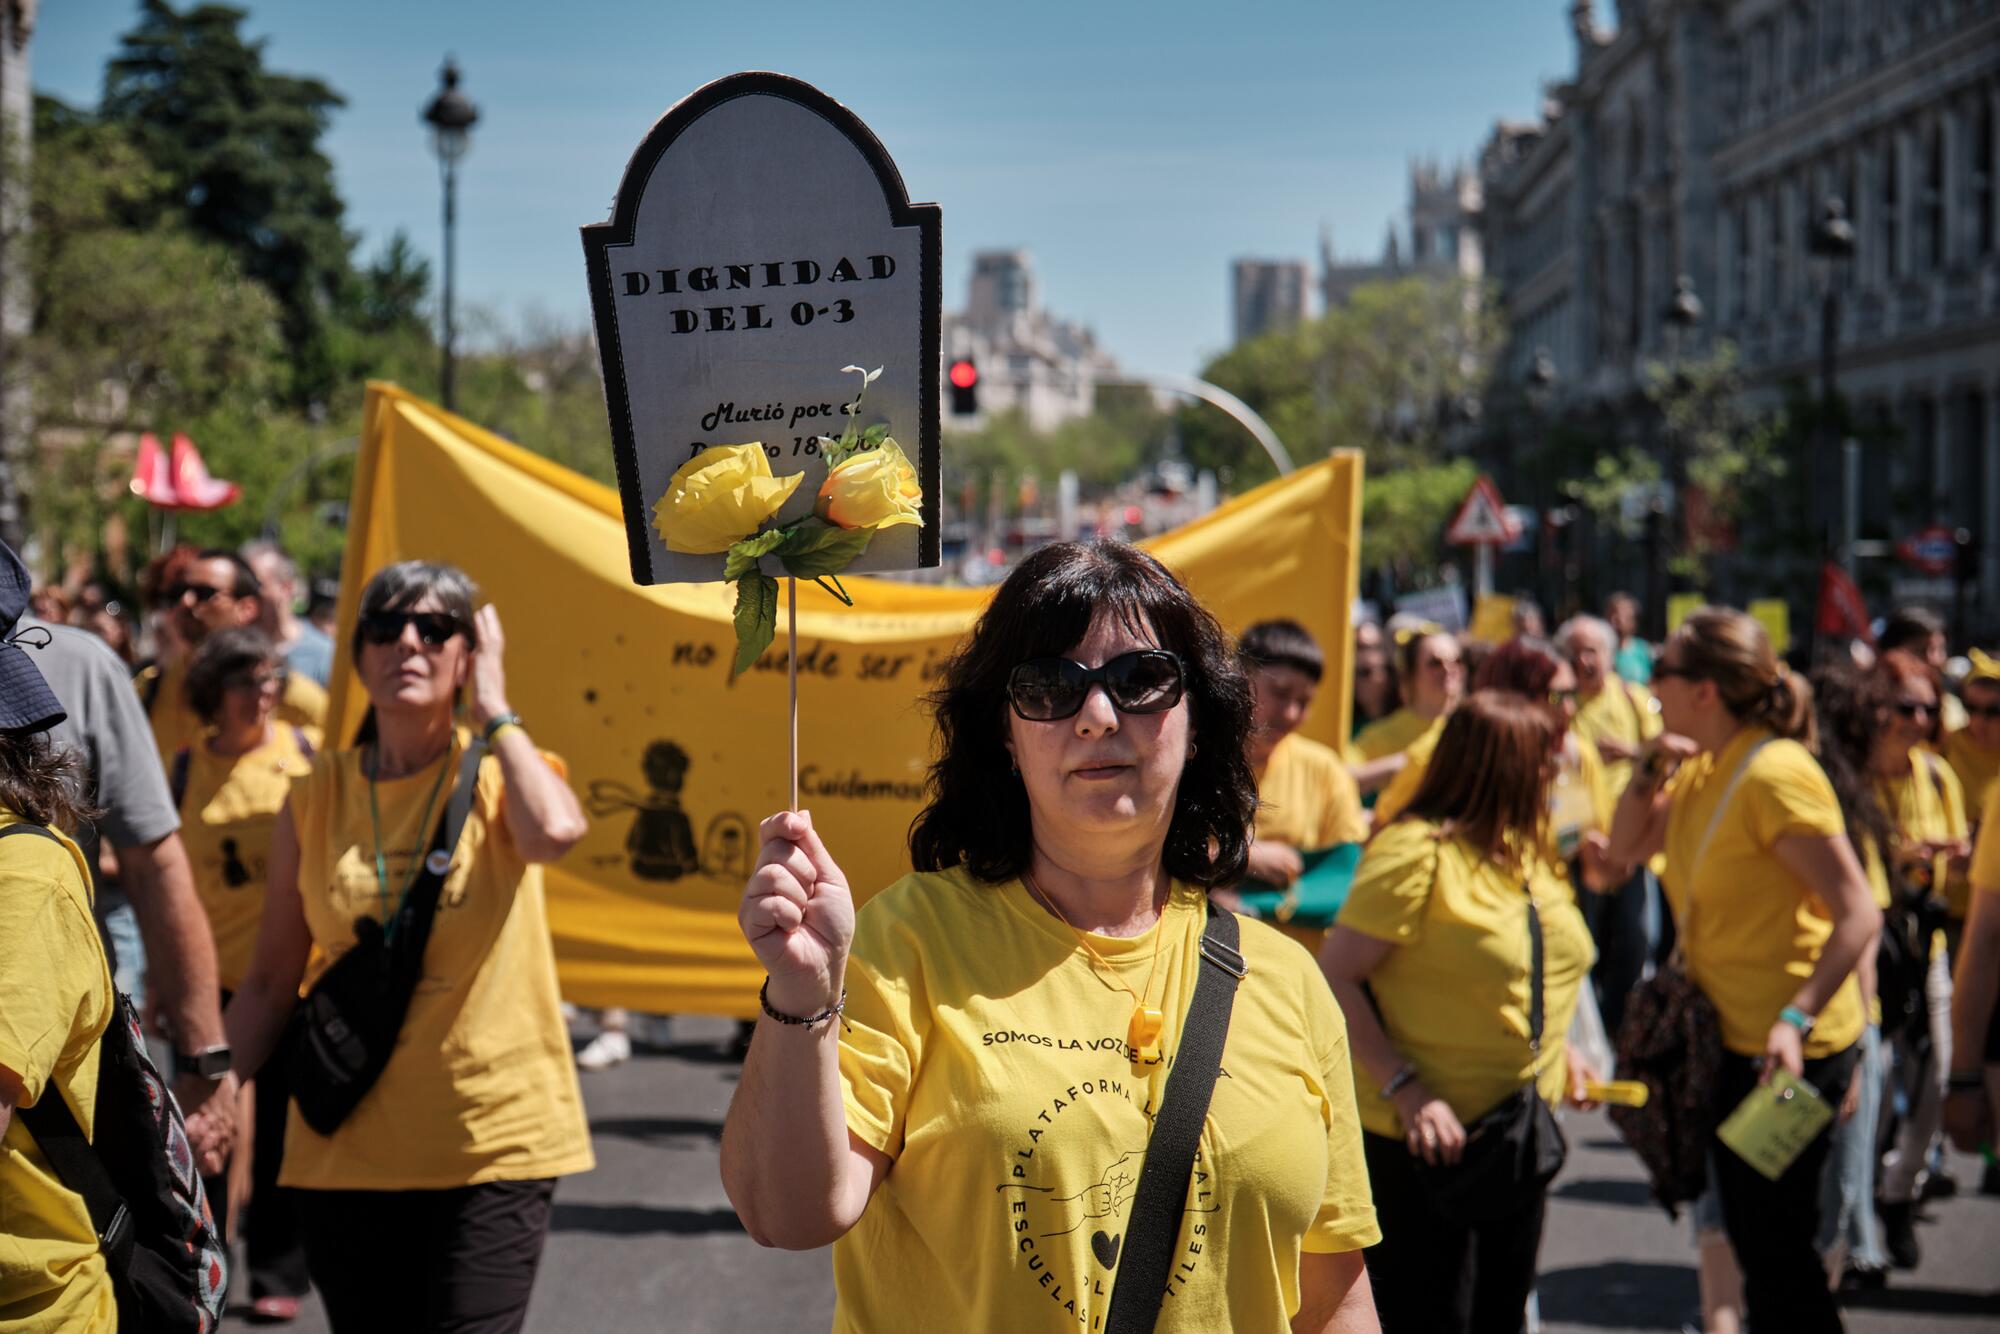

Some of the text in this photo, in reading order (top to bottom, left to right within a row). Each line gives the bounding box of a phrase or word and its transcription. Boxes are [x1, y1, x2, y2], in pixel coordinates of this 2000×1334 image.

[621, 255, 896, 296] DIGNIDAD
[670, 299, 855, 334] DEL 0-3
[701, 402, 785, 431] Murió
[789, 403, 832, 429] por
[672, 642, 717, 668] no
[857, 652, 914, 681] ser
[982, 1030, 1053, 1047] SOMOS
[1057, 1038, 1083, 1051] LA
[1086, 1037, 1122, 1055] VOZ
[1123, 1045, 1138, 1064] DE
[1013, 1079, 1132, 1178] PLATAFORMA
[1013, 1201, 1087, 1323] ESCUELAS
